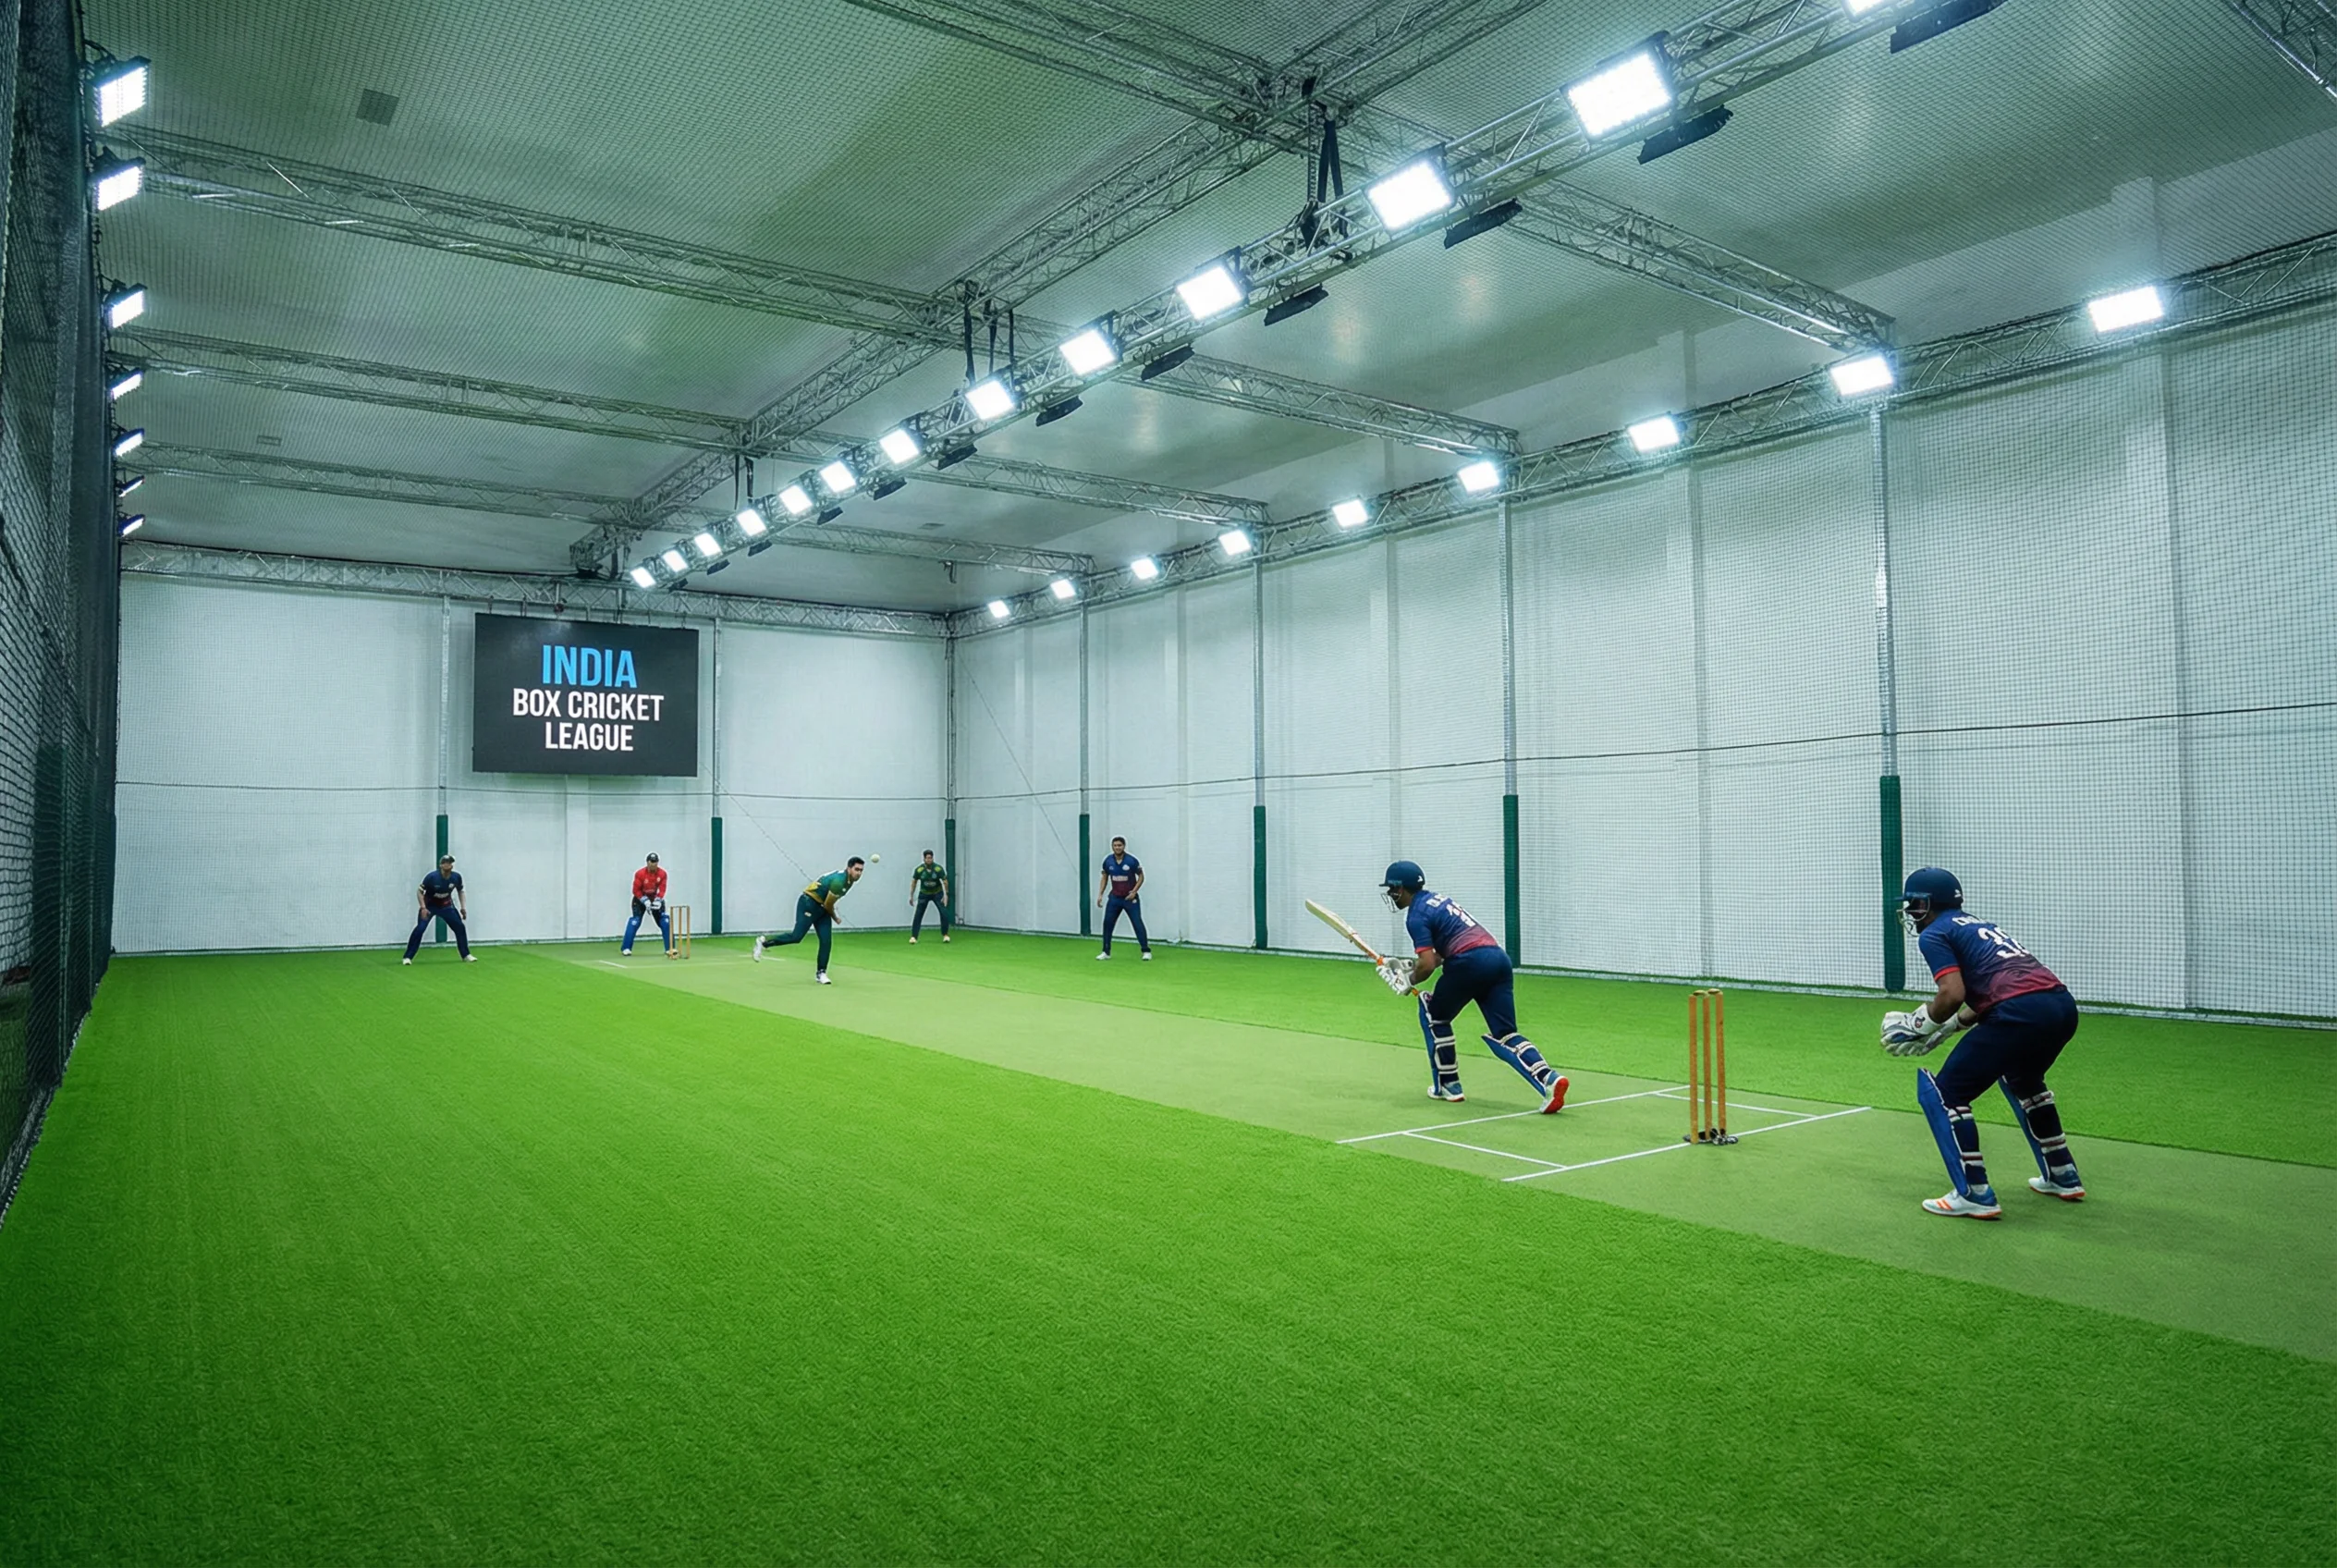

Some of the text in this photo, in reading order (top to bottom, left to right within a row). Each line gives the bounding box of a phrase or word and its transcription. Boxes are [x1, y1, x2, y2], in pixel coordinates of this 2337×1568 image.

[542, 644, 638, 689] INDIA
[512, 687, 665, 722] BOX CRICKET
[544, 721, 634, 752] LEAGUE
